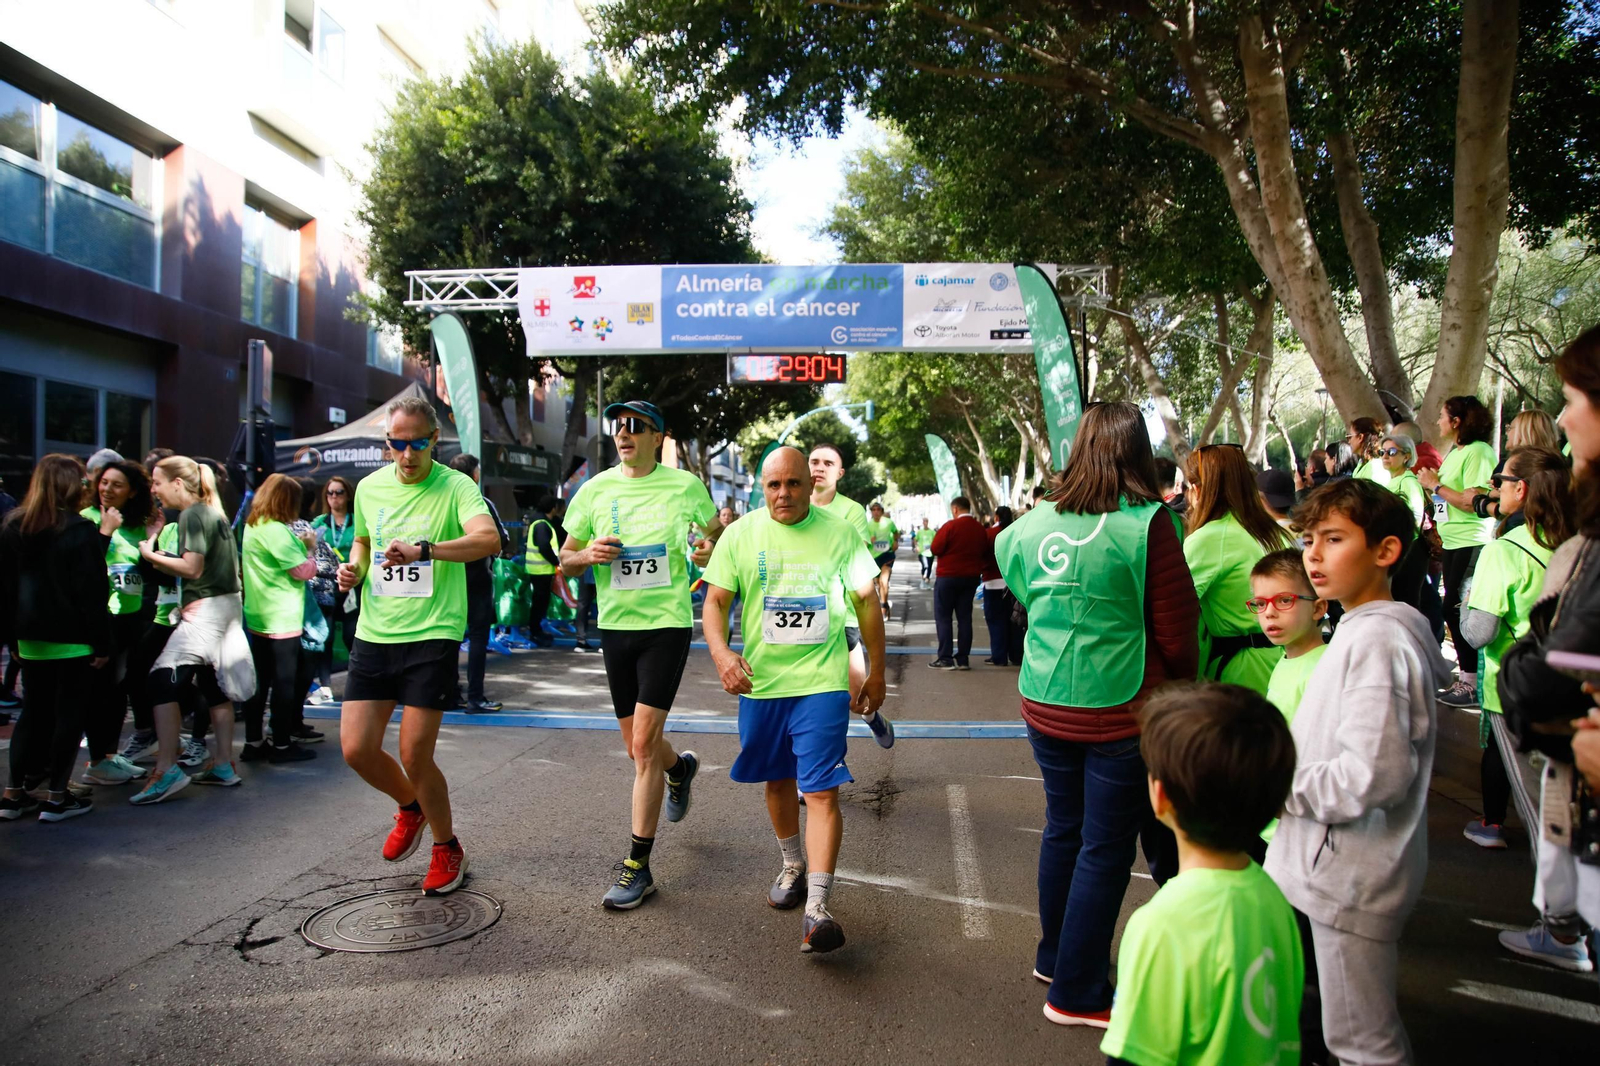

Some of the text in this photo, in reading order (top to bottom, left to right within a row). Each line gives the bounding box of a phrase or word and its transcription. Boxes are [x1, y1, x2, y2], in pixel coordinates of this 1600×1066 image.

[676, 273, 763, 293] Almería
[803, 273, 890, 291] marcha
[932, 275, 976, 287] cajamar
[676, 297, 861, 318] contra el cáncer
[999, 318, 1017, 328] Ejido
[323, 445, 394, 462] cruzandola
[384, 521, 430, 534] contra el
[621, 558, 658, 576] 573
[768, 562, 820, 571] En marcha
[115, 574, 142, 585] 1600
[383, 566, 420, 582] 315
[769, 571, 818, 581] contra el
[768, 582, 819, 594] cáncer
[775, 611, 815, 628] 327
